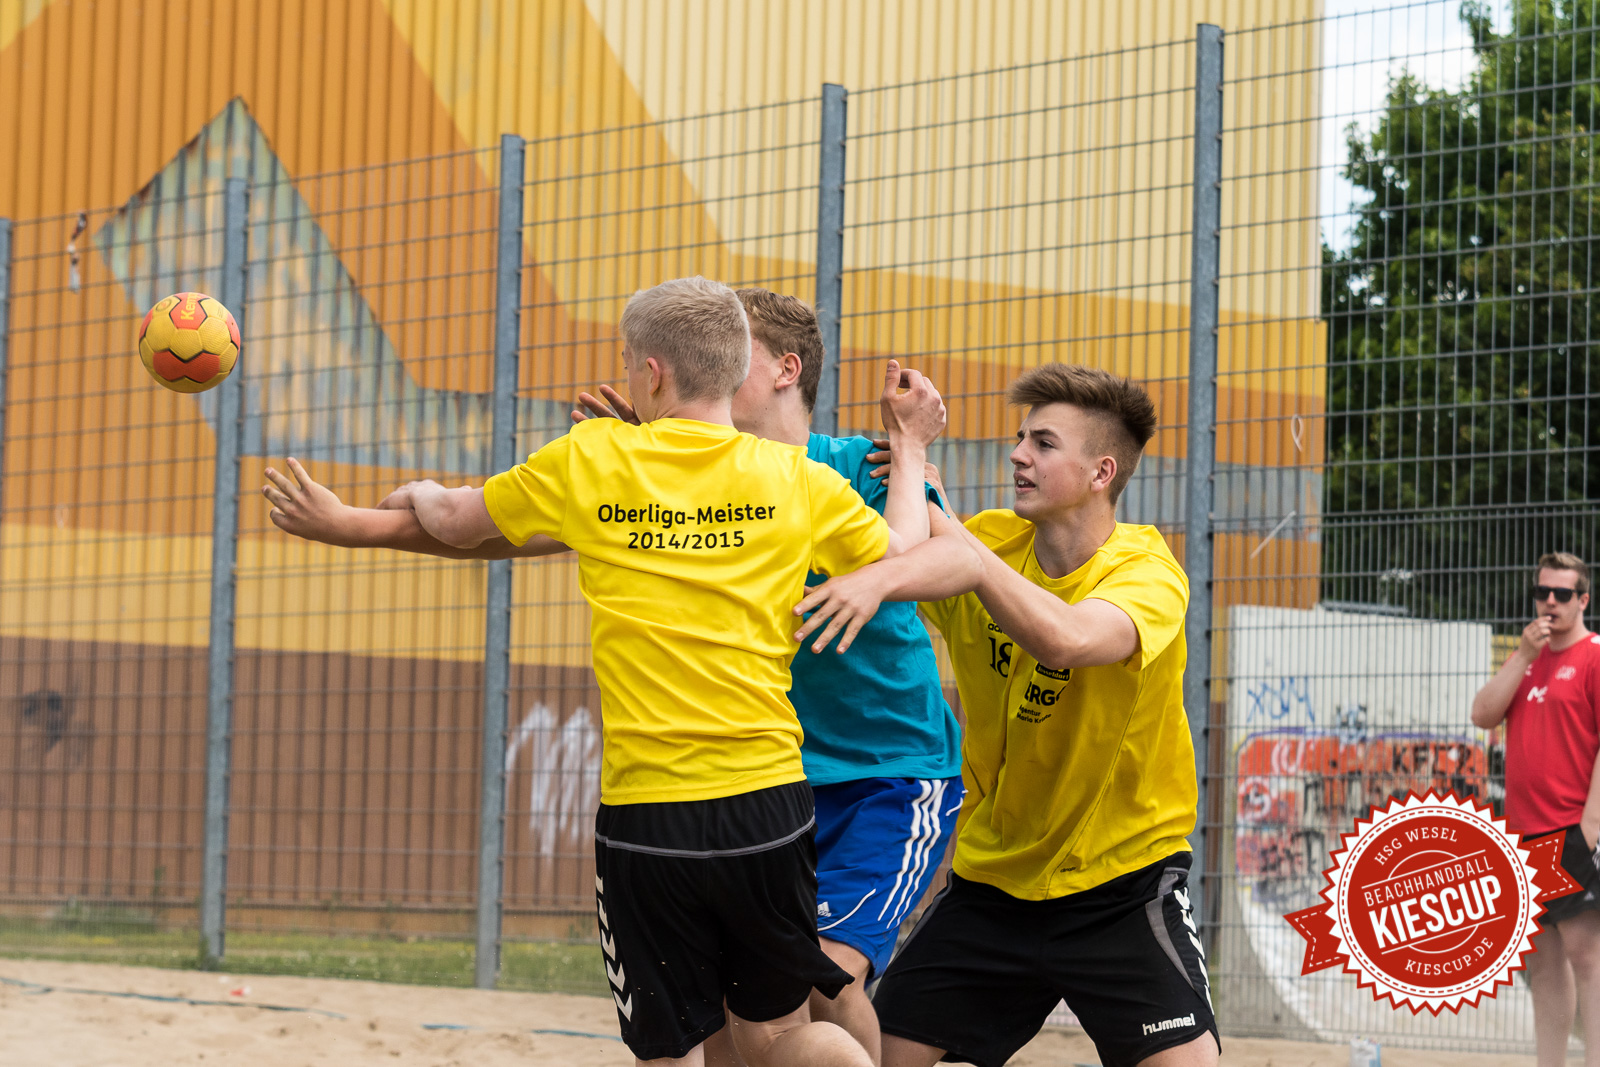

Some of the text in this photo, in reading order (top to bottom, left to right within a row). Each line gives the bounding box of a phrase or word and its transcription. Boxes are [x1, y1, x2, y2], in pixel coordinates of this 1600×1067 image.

[598, 503, 776, 529] Oberliga-Meister
[628, 531, 744, 549] 2014/2015
[988, 636, 1014, 679] 18
[1142, 1013, 1196, 1036] hummel
